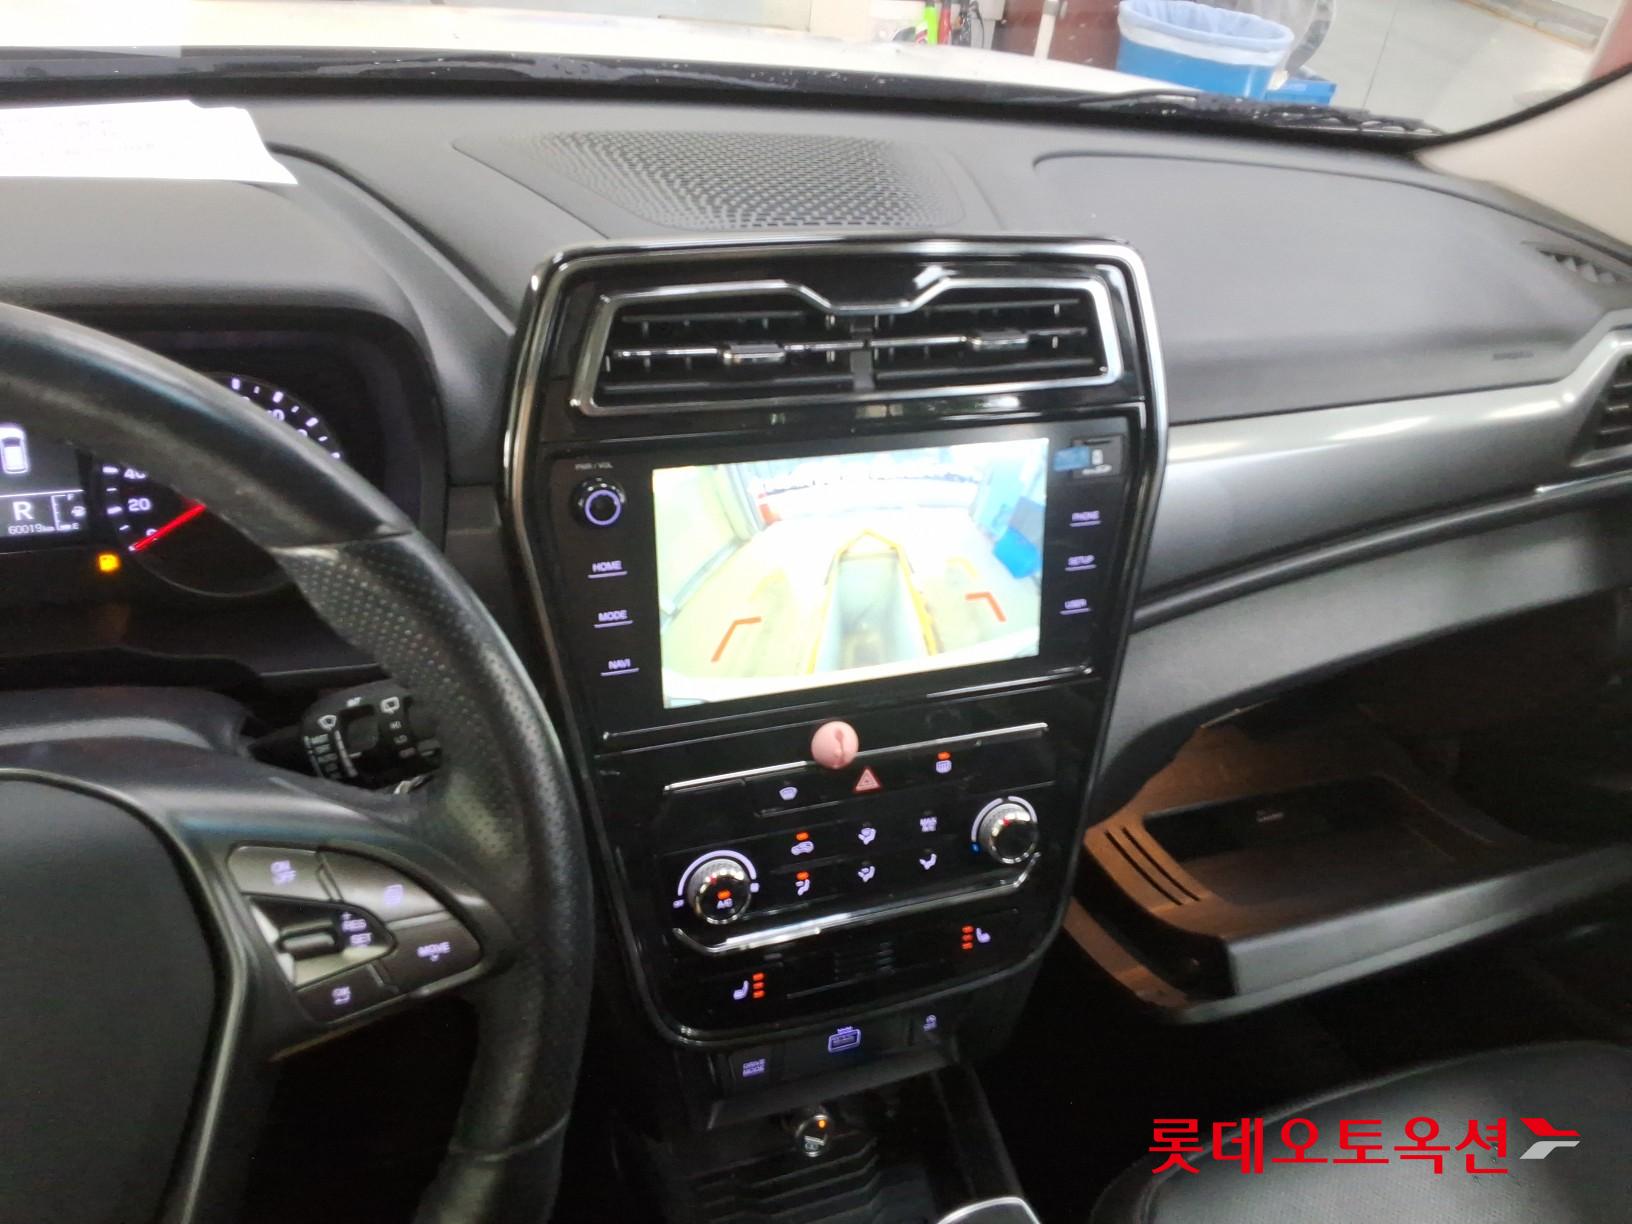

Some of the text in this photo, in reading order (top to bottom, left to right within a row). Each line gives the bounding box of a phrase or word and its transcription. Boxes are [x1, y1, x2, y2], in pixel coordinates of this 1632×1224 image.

[127, 497, 151, 512] 20
[12, 501, 34, 521] R
[1067, 554, 1095, 566] SETUP
[592, 560, 622, 573] HOME
[598, 610, 628, 622] MODE
[608, 658, 631, 670] NAVI
